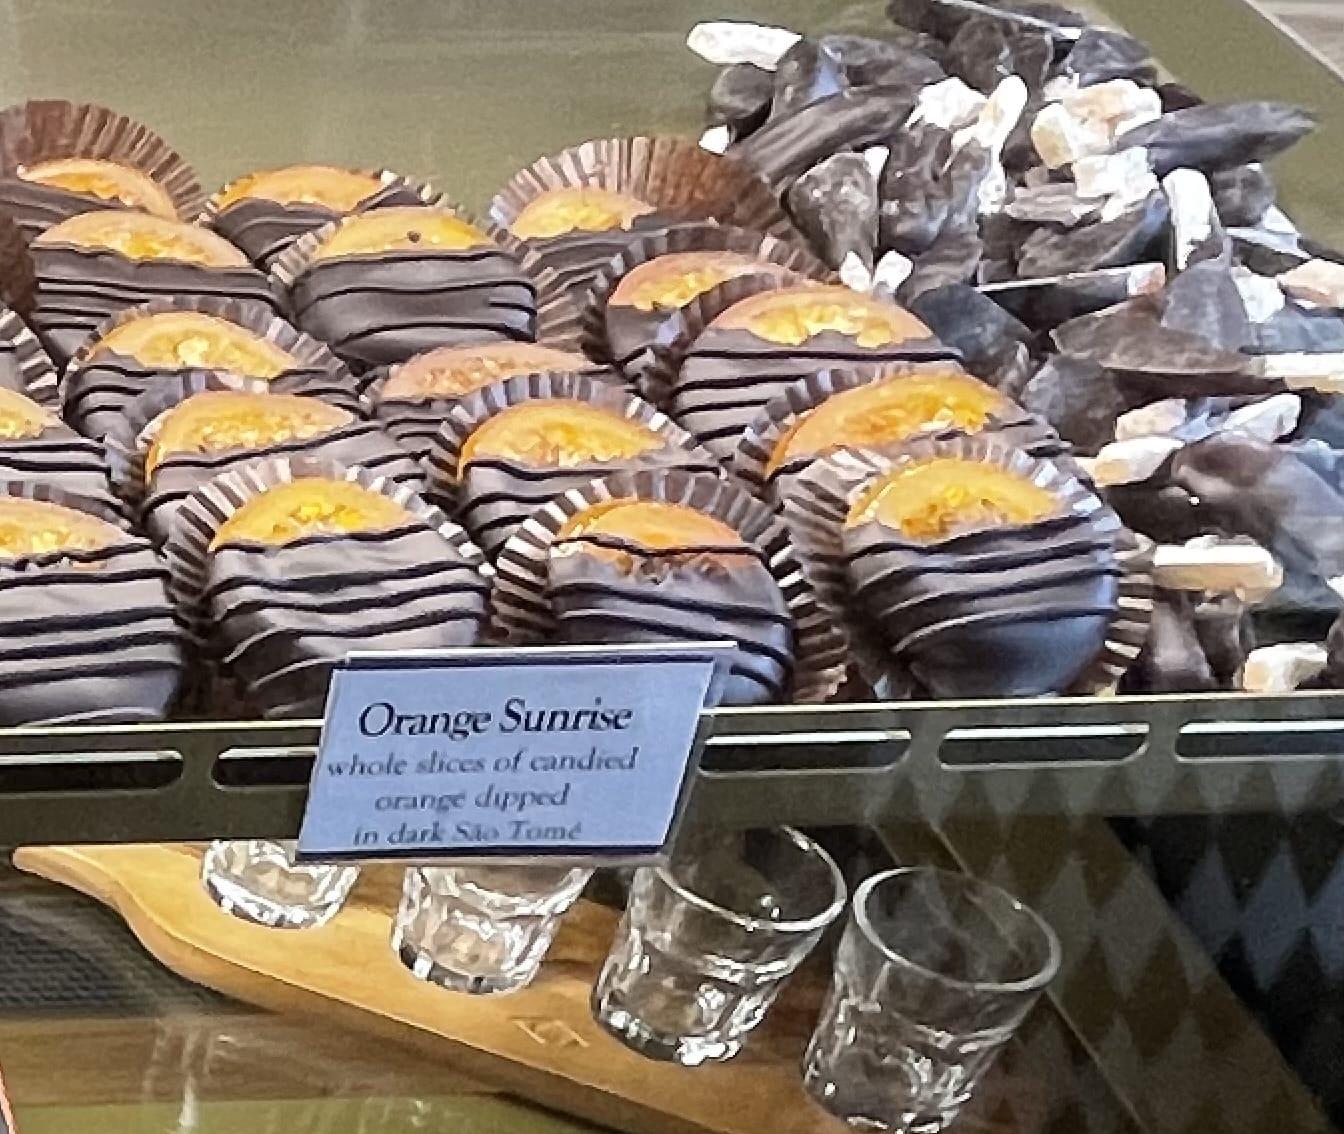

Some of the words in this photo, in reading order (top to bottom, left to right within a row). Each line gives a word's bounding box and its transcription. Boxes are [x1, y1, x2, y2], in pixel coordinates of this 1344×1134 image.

[359, 702, 492, 739] Orange
[500, 697, 632, 734] Sunrise
[327, 753, 408, 777] whole
[416, 750, 485, 774] slices
[492, 746, 523, 773] of
[530, 746, 639, 772] candied
[374, 791, 466, 814] orange
[475, 784, 570, 812] dipped
[353, 826, 380, 846] in
[388, 824, 443, 844] dark
[509, 819, 582, 841] Tomé
